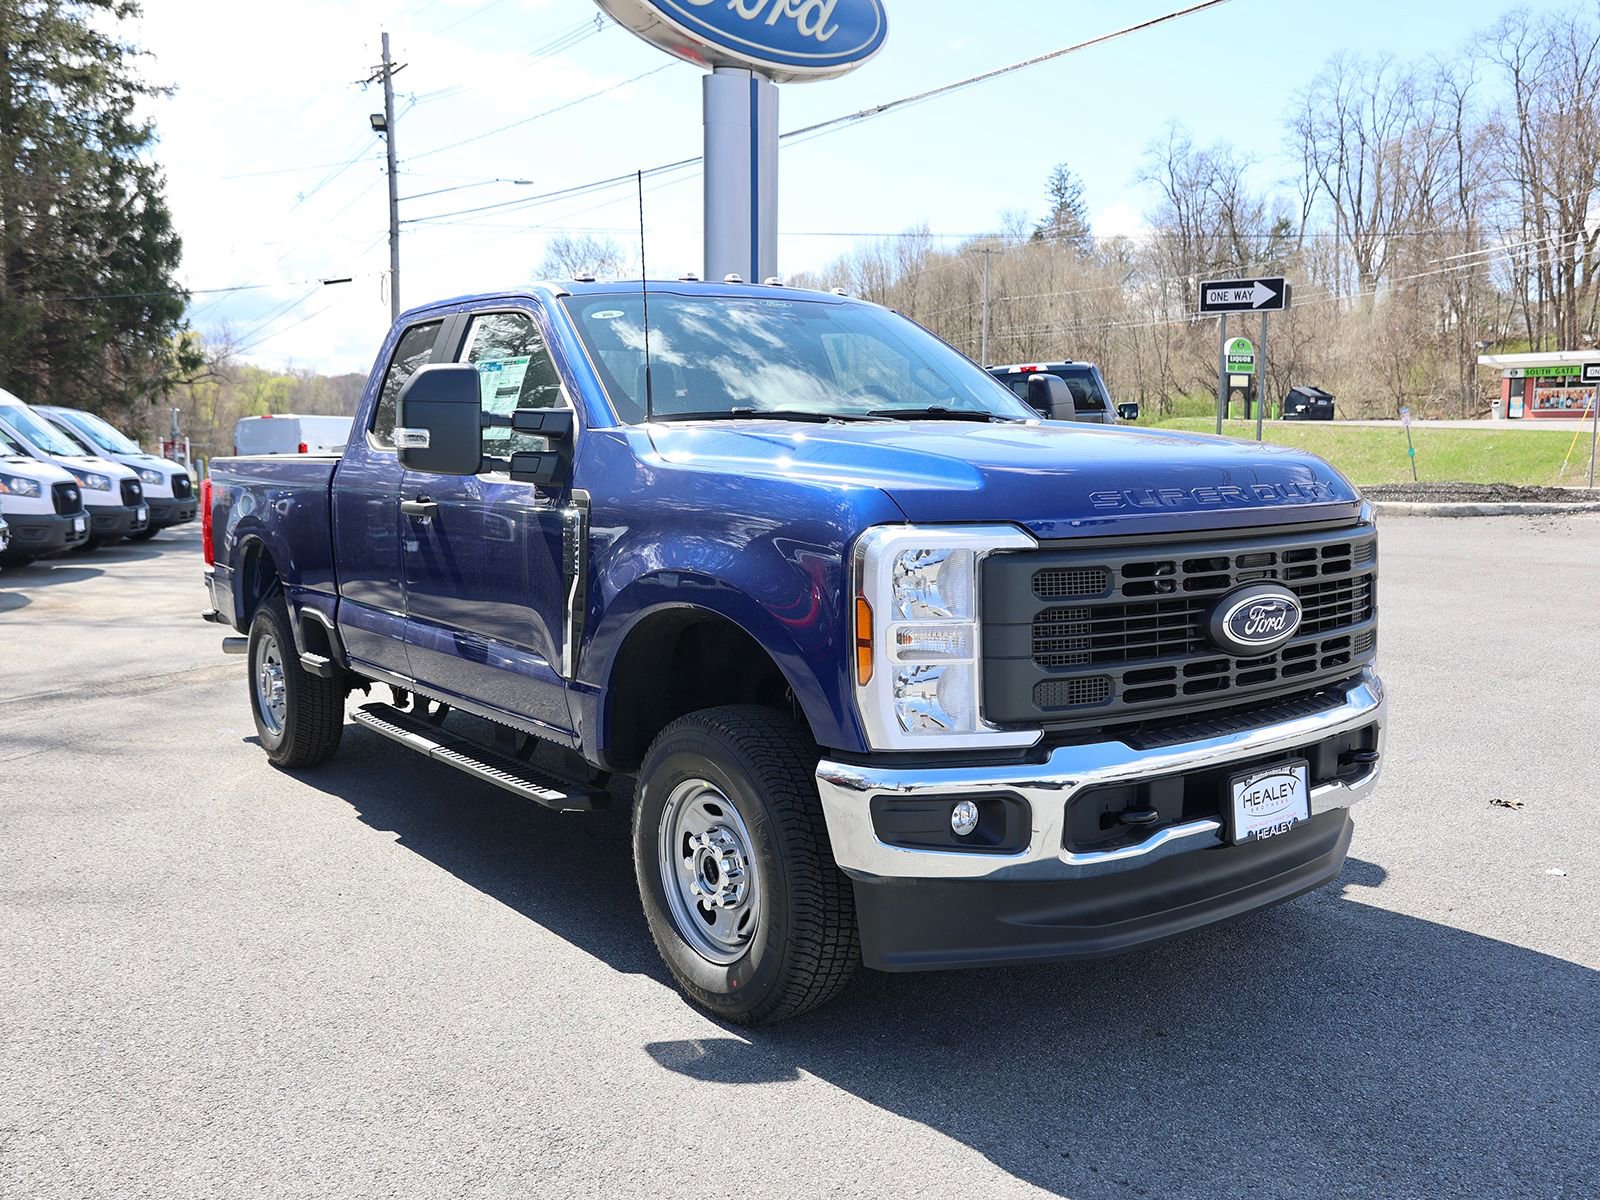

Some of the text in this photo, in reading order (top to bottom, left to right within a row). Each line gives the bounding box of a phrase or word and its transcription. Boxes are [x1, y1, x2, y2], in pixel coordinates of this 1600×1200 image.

[687, 0, 839, 41] ord
[1210, 290, 1254, 302] ONE WAY
[1229, 355, 1251, 363] LIQUOR
[1525, 368, 1551, 376] SOUTH
[1555, 367, 1574, 375] GATE
[1088, 480, 1336, 509] SUPER DUTY
[1244, 604, 1287, 635] Ford
[1242, 780, 1297, 809] HEALEY
[1256, 821, 1293, 841] HEALEY
